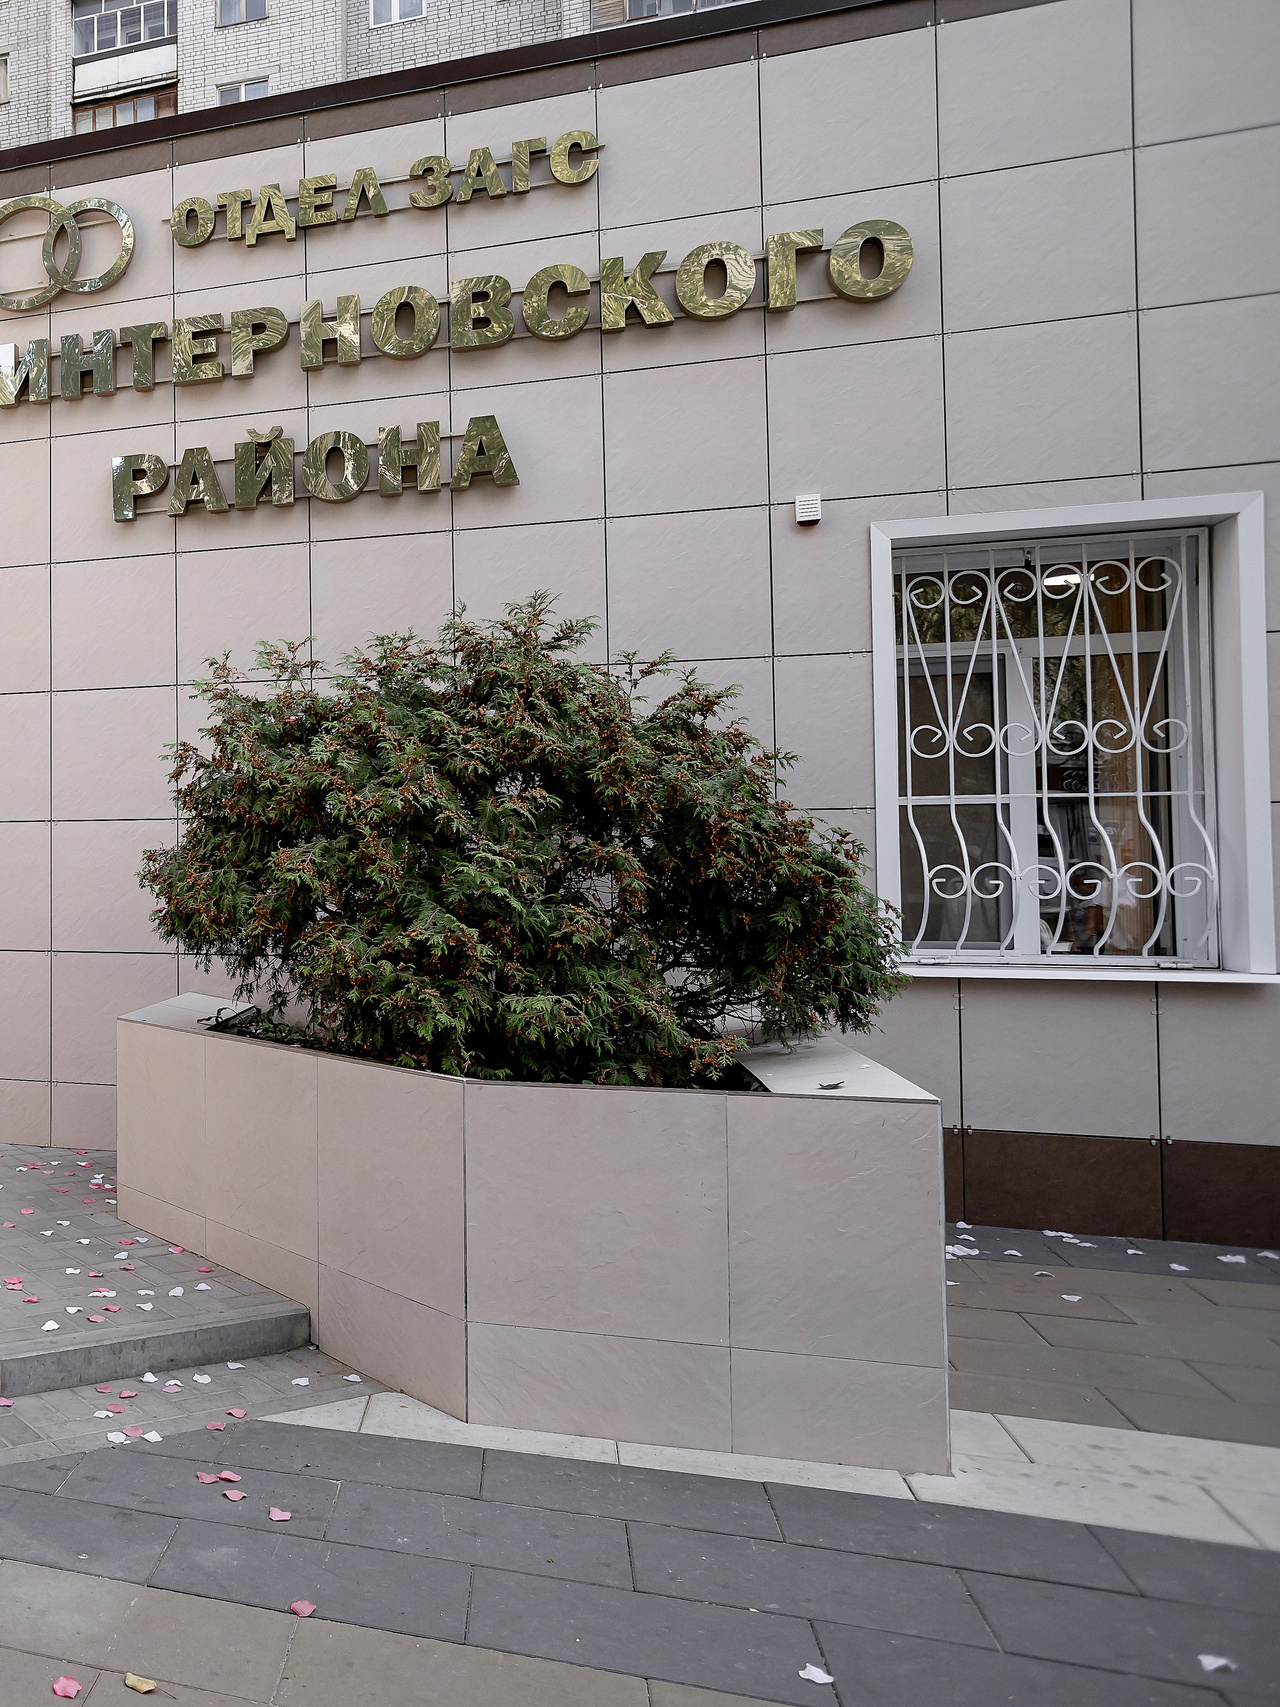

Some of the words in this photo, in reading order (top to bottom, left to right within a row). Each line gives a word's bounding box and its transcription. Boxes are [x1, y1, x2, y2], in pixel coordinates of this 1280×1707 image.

[170, 166, 390, 248] ОТДЕЛ
[408, 130, 599, 209] ЗАГС
[111, 415, 519, 523] РАЙОНА
